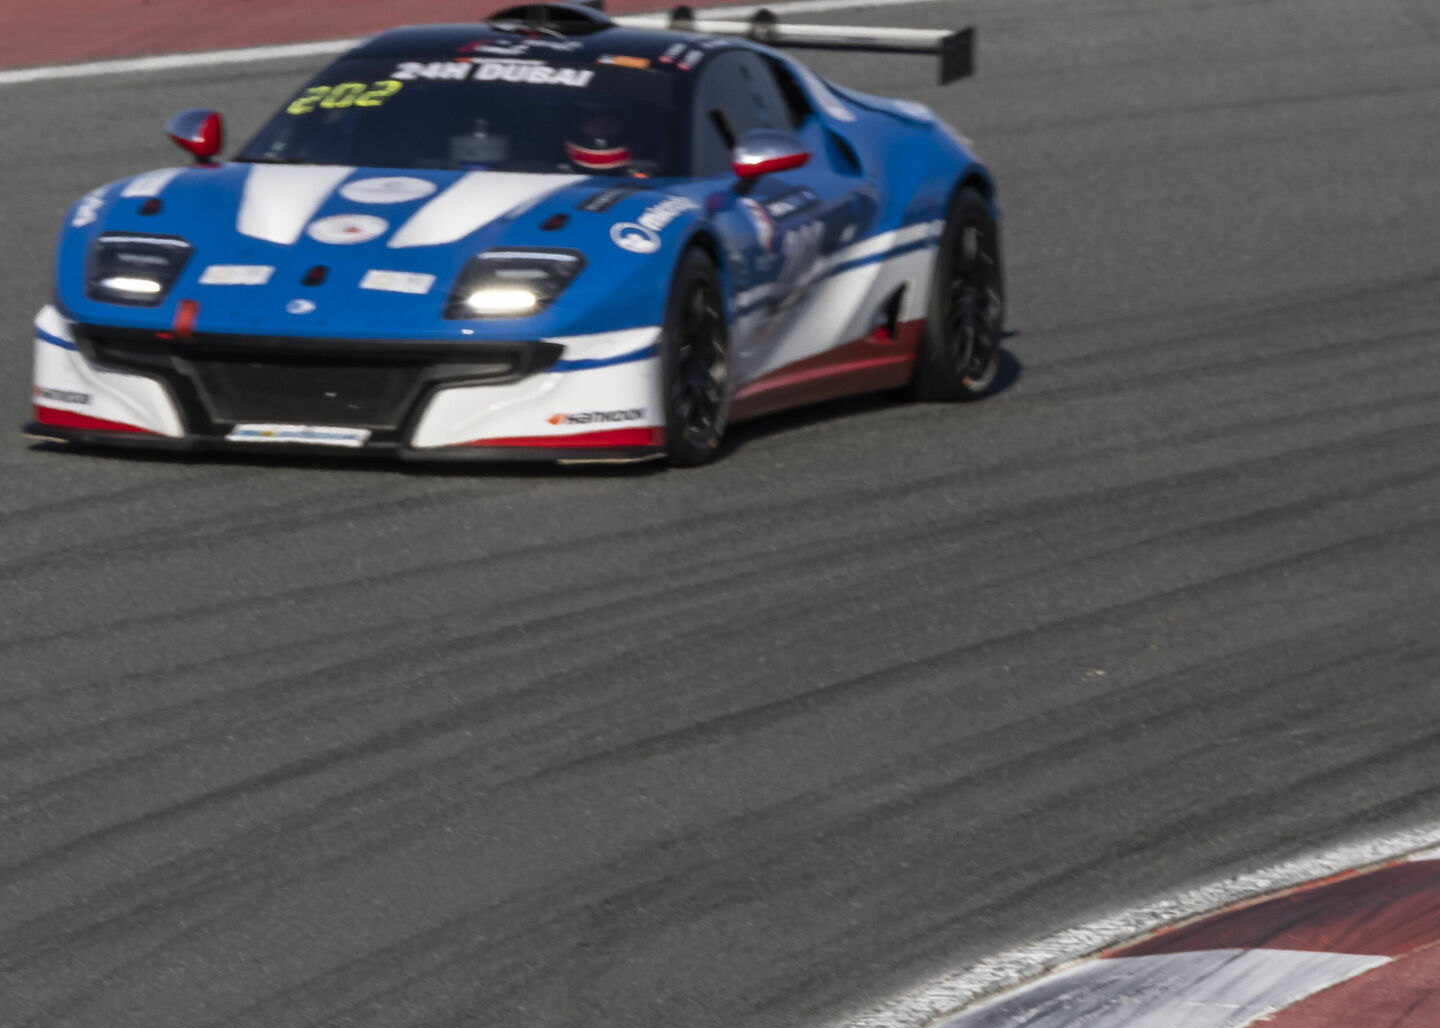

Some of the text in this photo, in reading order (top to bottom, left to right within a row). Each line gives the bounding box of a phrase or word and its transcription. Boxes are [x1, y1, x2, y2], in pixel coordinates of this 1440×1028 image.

[390, 61, 472, 80] 24H
[474, 63, 595, 87] DUBAI
[286, 80, 404, 115] 202
